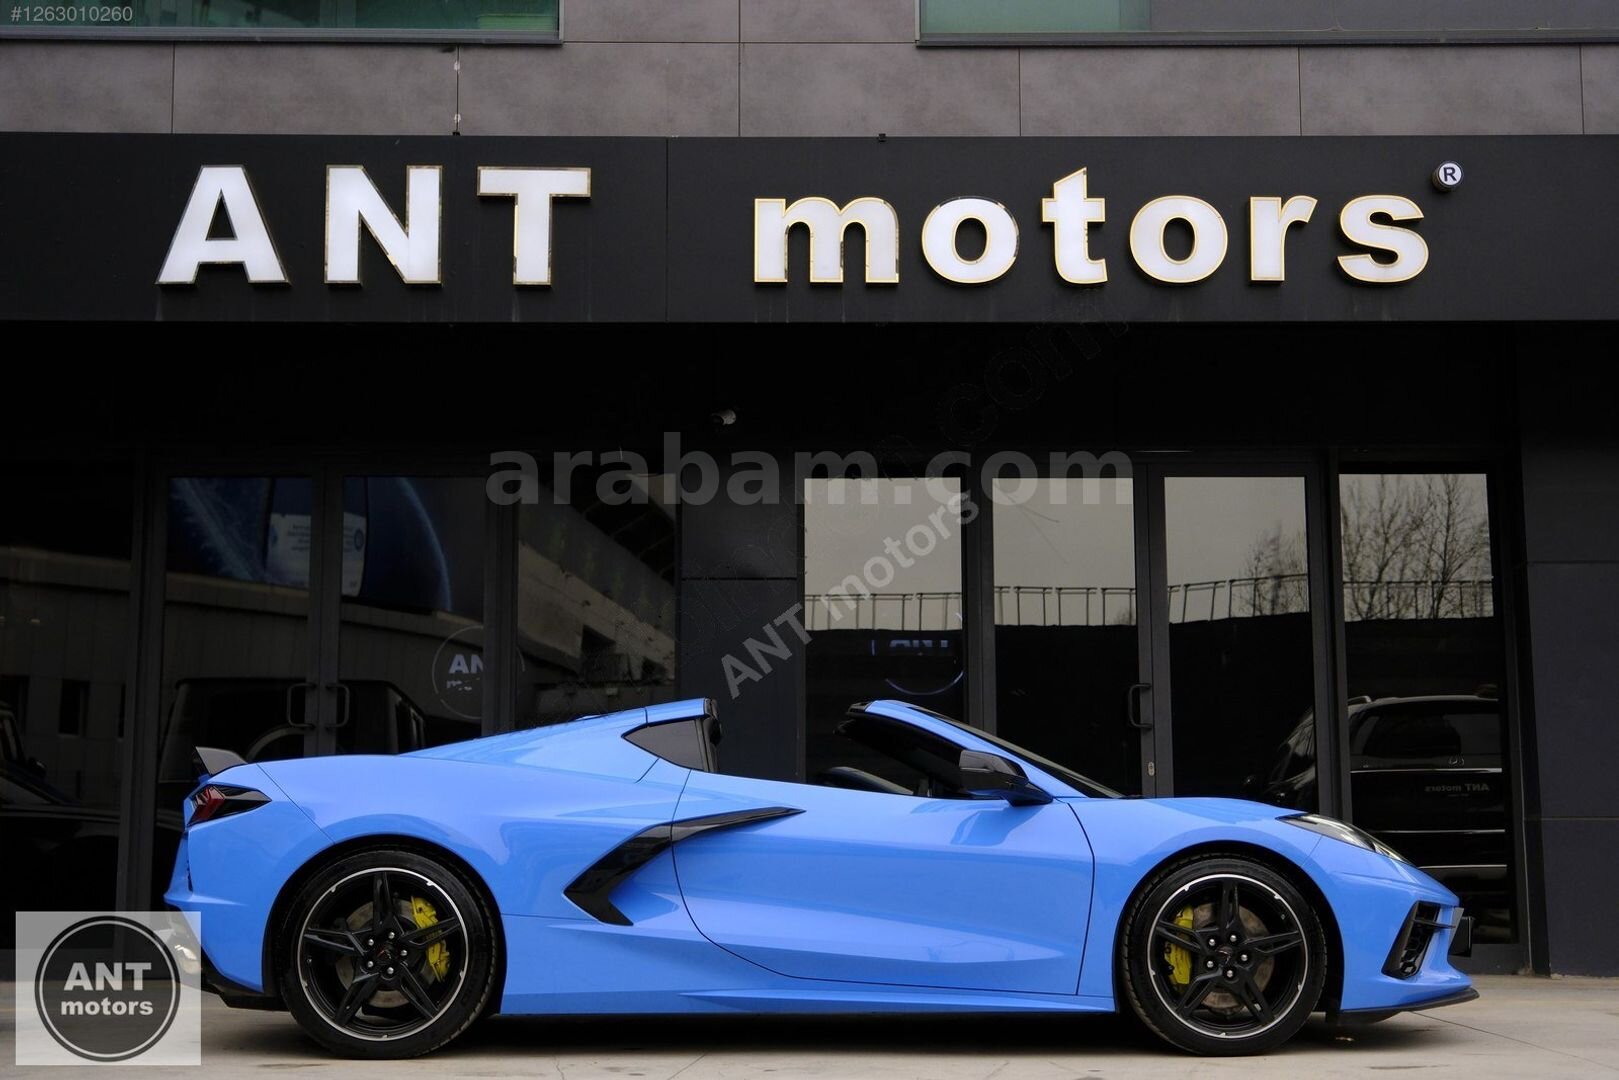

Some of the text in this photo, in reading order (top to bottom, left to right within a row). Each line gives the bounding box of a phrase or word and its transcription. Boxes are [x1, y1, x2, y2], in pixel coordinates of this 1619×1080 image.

[156, 165, 591, 286] ANT
[754, 167, 1429, 285] motors
[448, 654, 484, 674] AN
